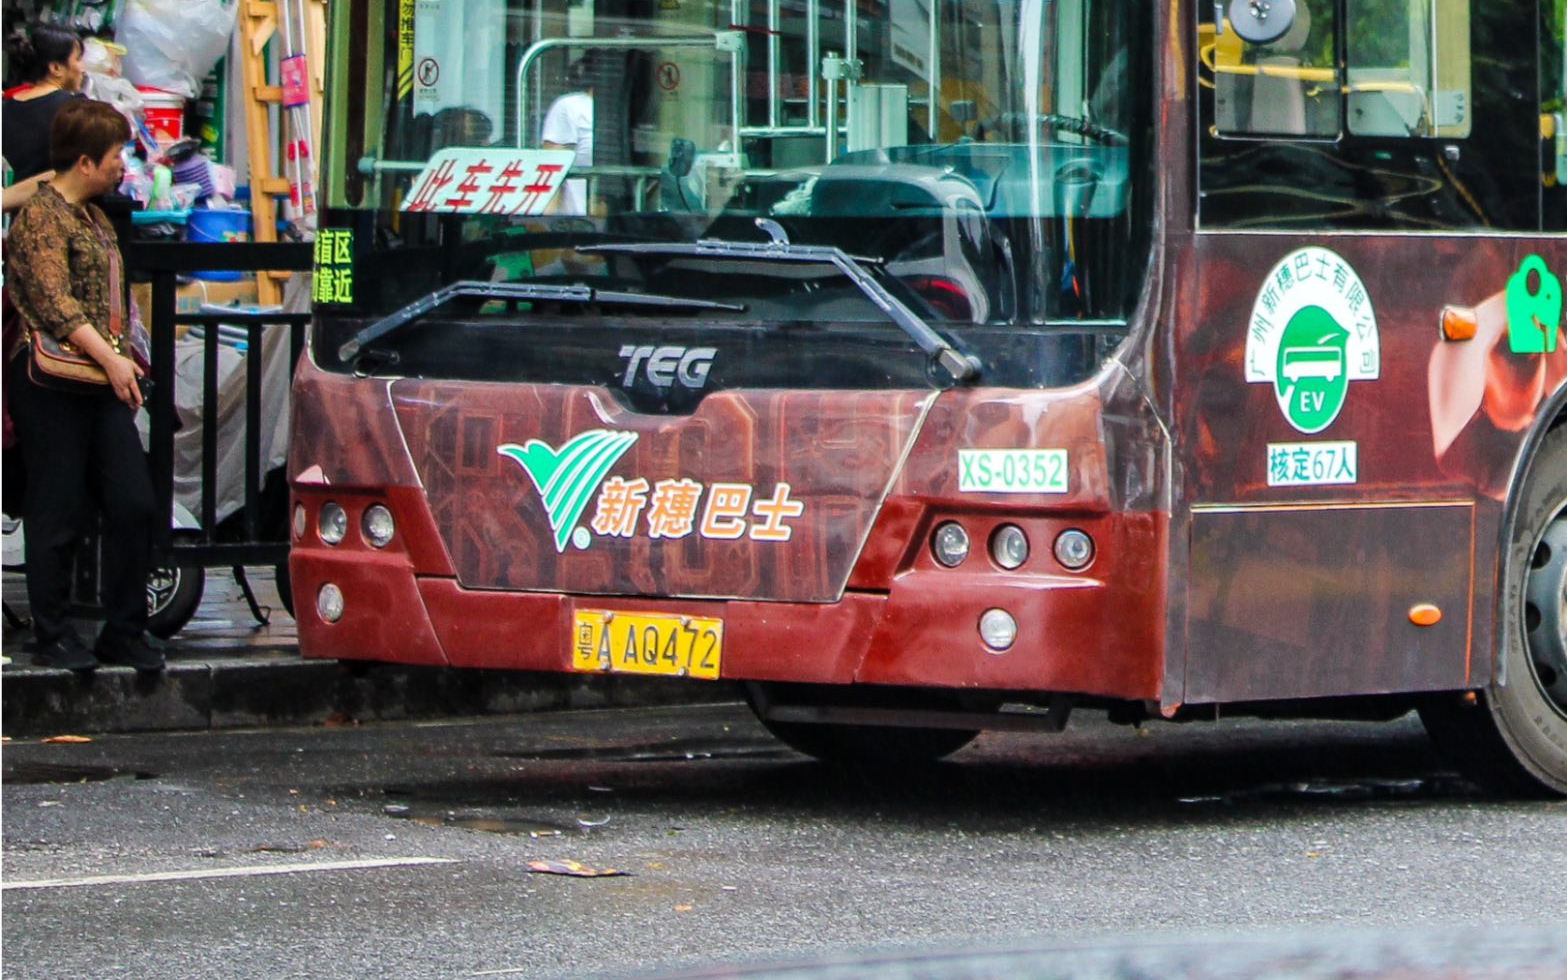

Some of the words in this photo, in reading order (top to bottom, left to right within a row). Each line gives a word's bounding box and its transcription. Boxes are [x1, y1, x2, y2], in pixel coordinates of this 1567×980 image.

[407, 158, 564, 215] 此车先开
[1249, 252, 1377, 377] 广州新穗巴士有限公司
[618, 344, 718, 388] TEG
[1300, 391, 1326, 412] EV
[960, 452, 1065, 489] XS-0352
[1270, 447, 1354, 483] 核定67人
[592, 477, 806, 542] 新穗巴士
[623, 624, 717, 669] AQ472
